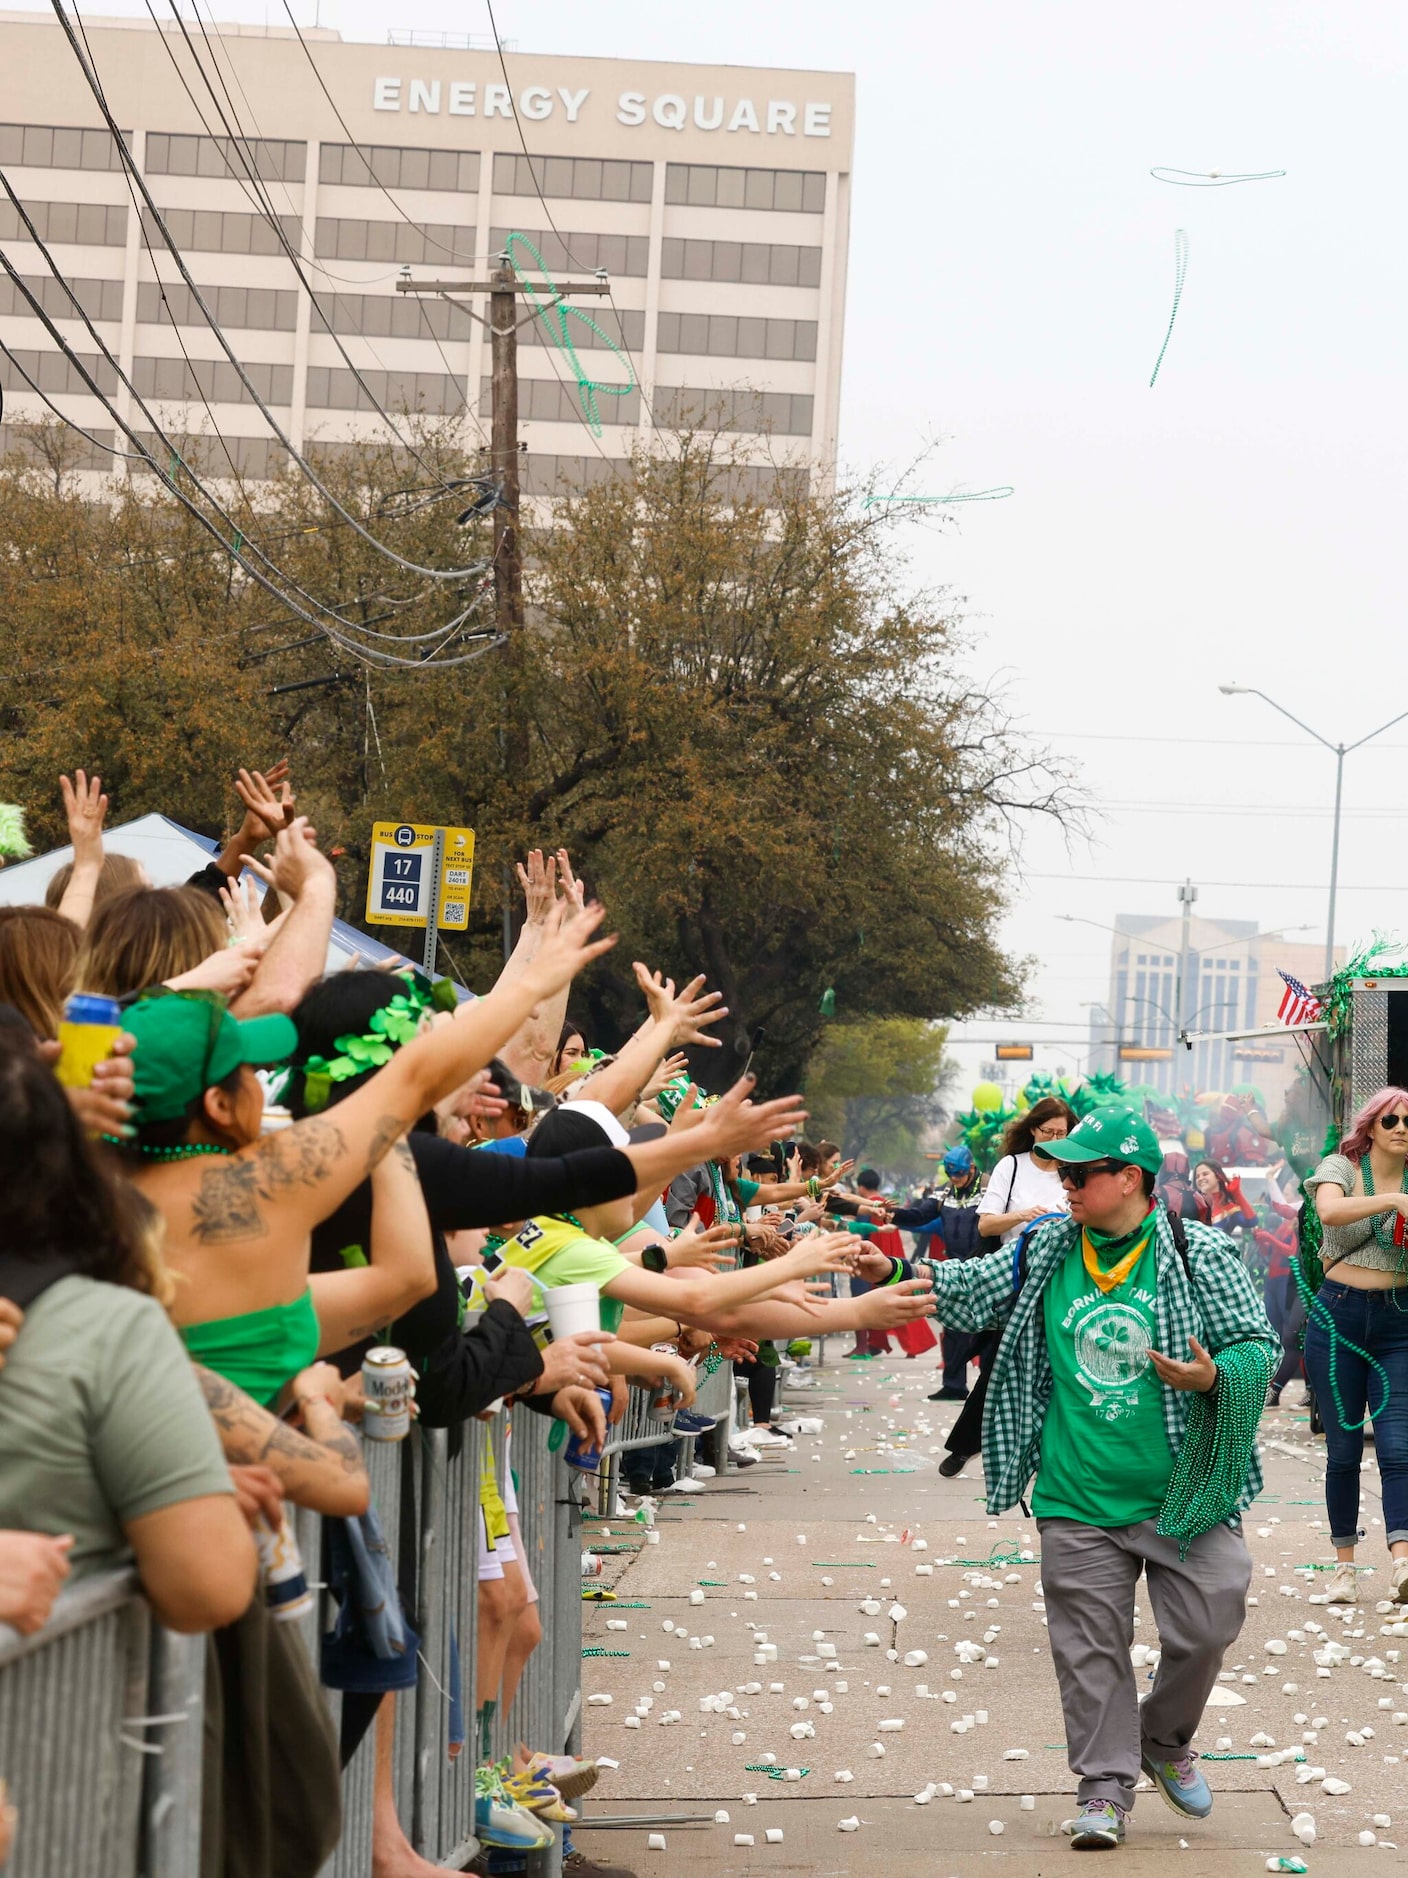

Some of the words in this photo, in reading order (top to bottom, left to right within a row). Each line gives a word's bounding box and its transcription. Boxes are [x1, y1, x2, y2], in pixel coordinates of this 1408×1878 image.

[373, 76, 590, 122] ENERGY
[616, 91, 832, 137] SQUARE
[393, 858, 413, 876] 17
[385, 886, 415, 905] 440
[1061, 1292, 1096, 1329] BORN
